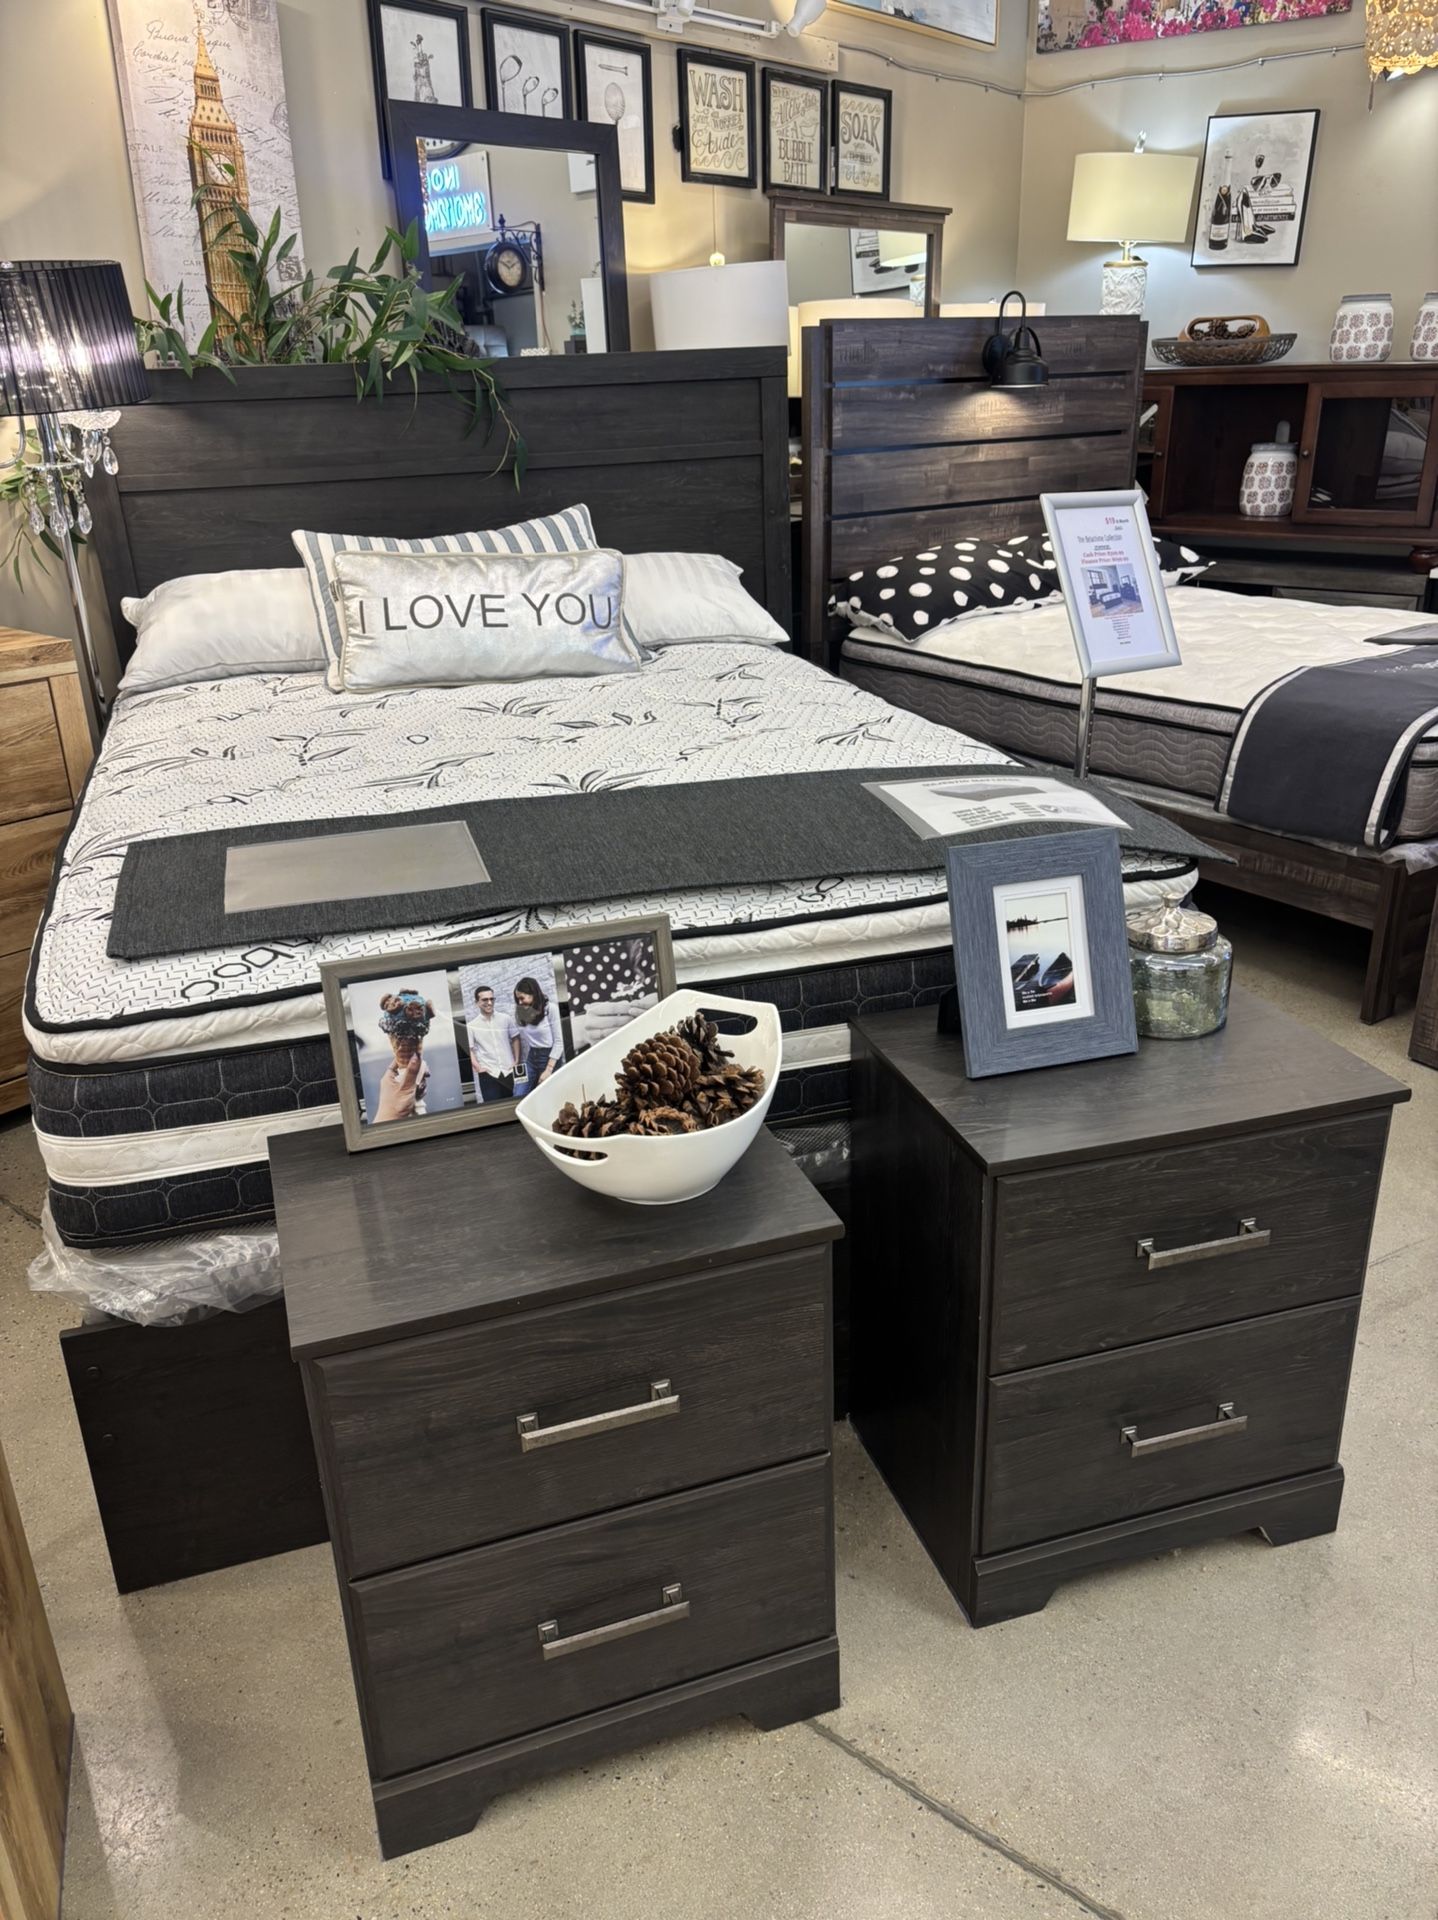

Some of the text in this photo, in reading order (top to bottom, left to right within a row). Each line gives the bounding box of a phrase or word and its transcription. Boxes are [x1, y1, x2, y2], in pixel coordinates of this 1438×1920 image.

[689, 69, 744, 113] WASH
[778, 138, 814, 163] BUBBLE
[841, 110, 881, 154] SOAK
[783, 161, 808, 185] BATH
[358, 592, 612, 634] I LOVE YOU
